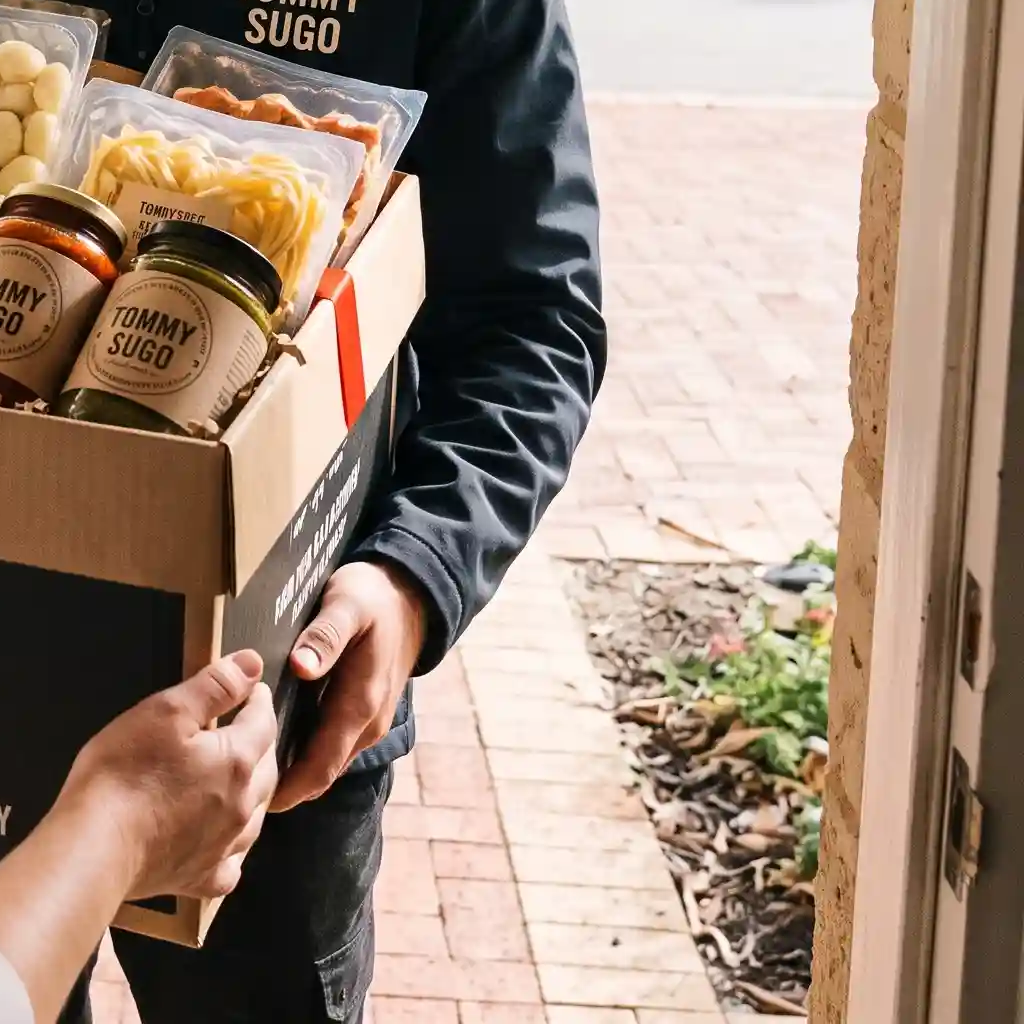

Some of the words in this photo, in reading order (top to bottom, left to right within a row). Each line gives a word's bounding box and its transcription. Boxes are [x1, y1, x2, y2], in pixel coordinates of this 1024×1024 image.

[244, 7, 341, 54] SUGO
[110, 306, 198, 346] TOMMY
[107, 331, 175, 370] SUGO
